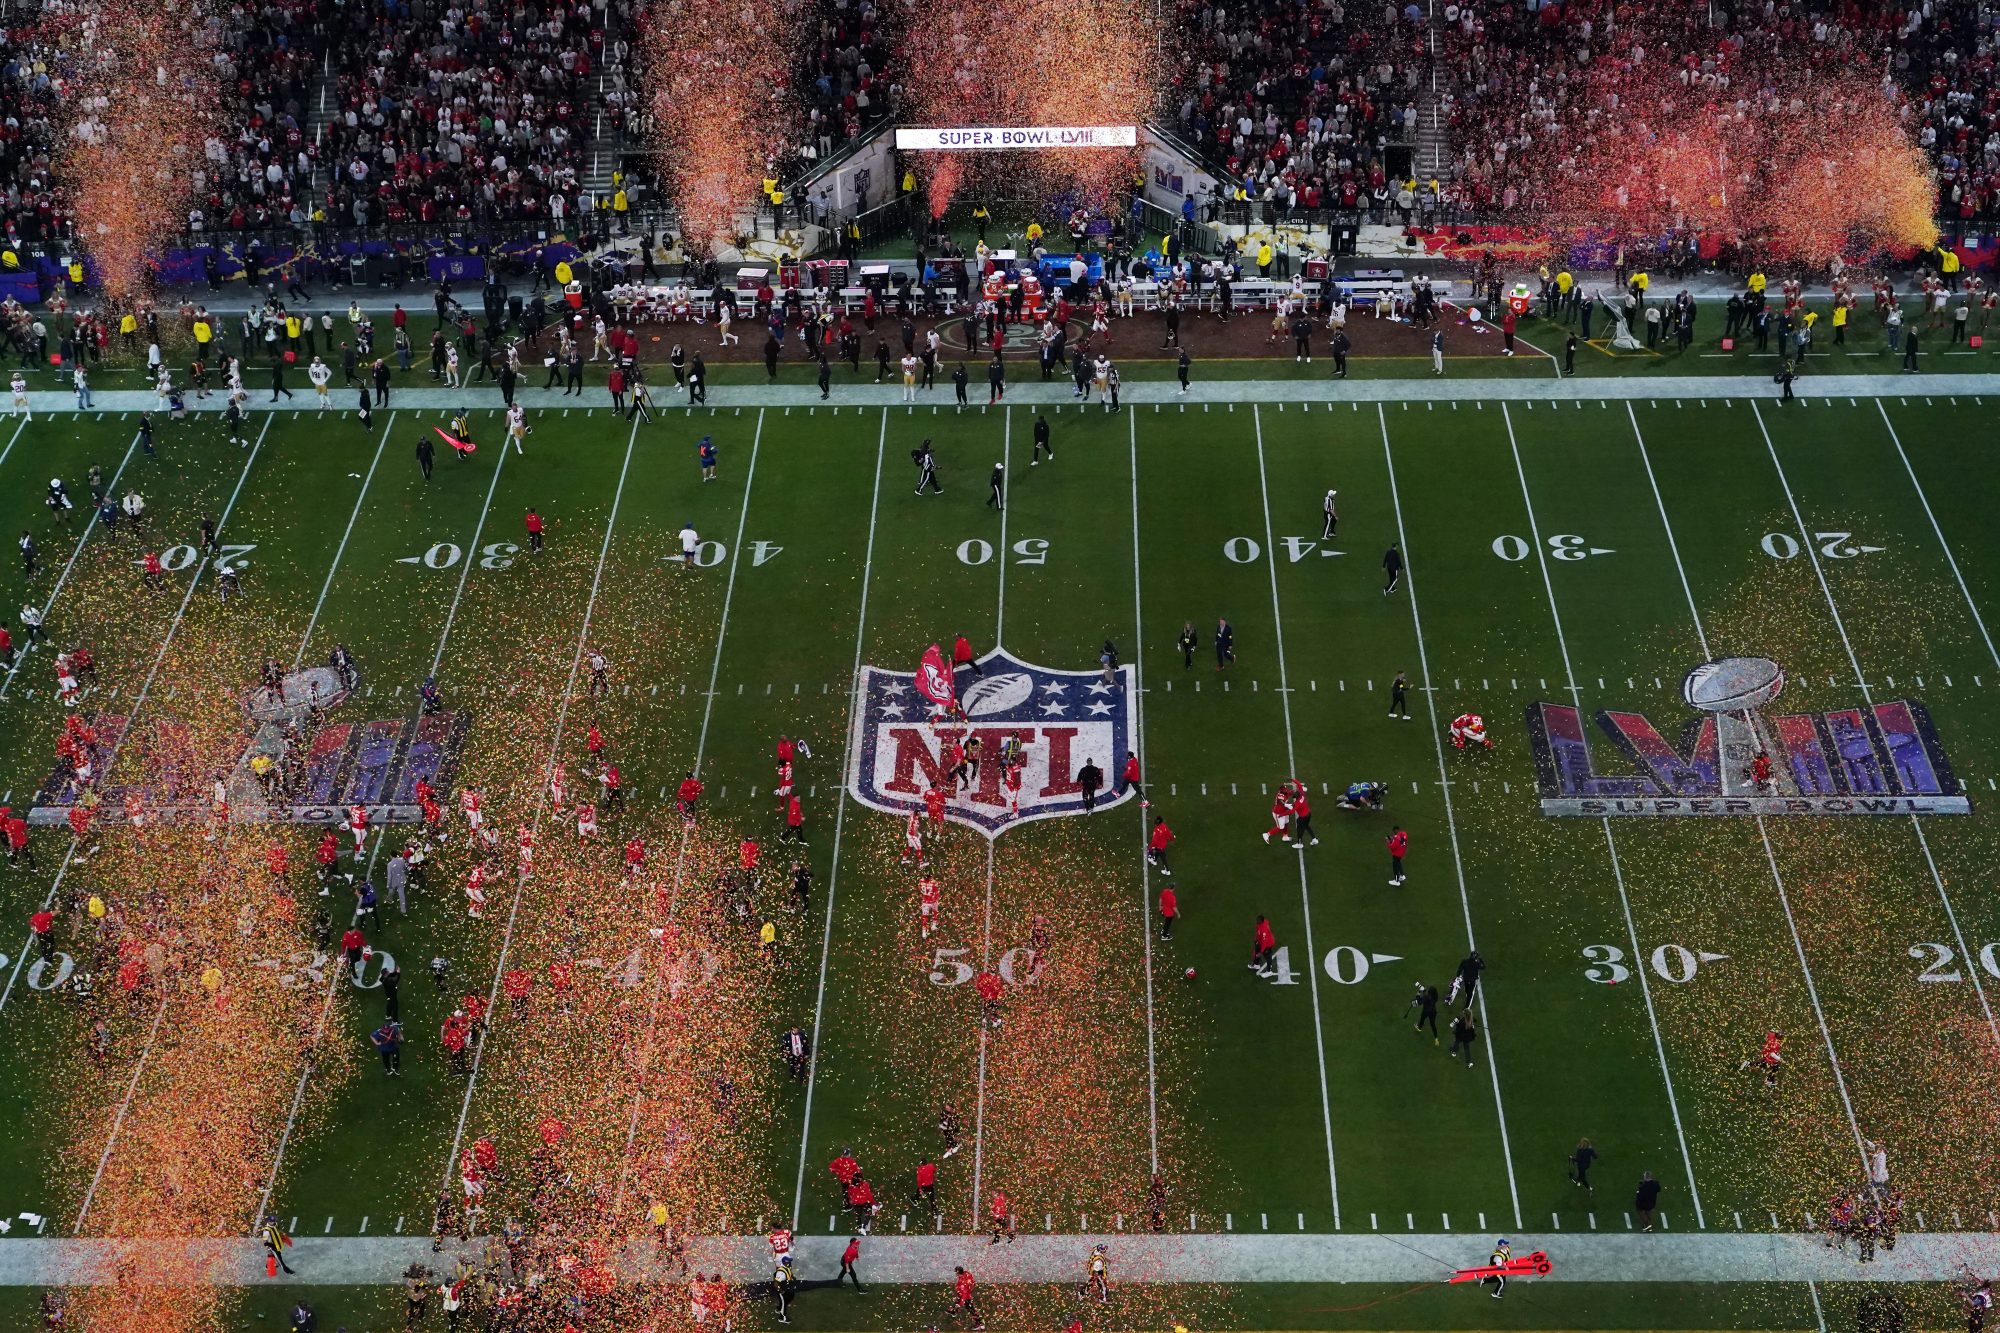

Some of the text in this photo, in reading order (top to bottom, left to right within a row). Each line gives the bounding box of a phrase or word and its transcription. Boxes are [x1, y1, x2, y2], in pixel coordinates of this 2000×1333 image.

[1294, 69, 1302, 77] 23
[938, 129, 1094, 145] SUPER BOWL LVIII
[1513, 300, 1522, 310] G
[424, 543, 519, 570] 30
[694, 541, 784, 568] 40
[956, 538, 1050, 566] 50
[1223, 535, 1317, 564] 40
[1491, 533, 1587, 562] 30
[1532, 699, 1949, 798] LVIII
[884, 727, 1104, 808] NFL
[1580, 798, 1935, 815] SUPER BOWL
[928, 947, 1046, 987] 50
[1256, 945, 1370, 985] 40
[1582, 943, 1698, 984] 30
[773, 1238, 788, 1250] 23
